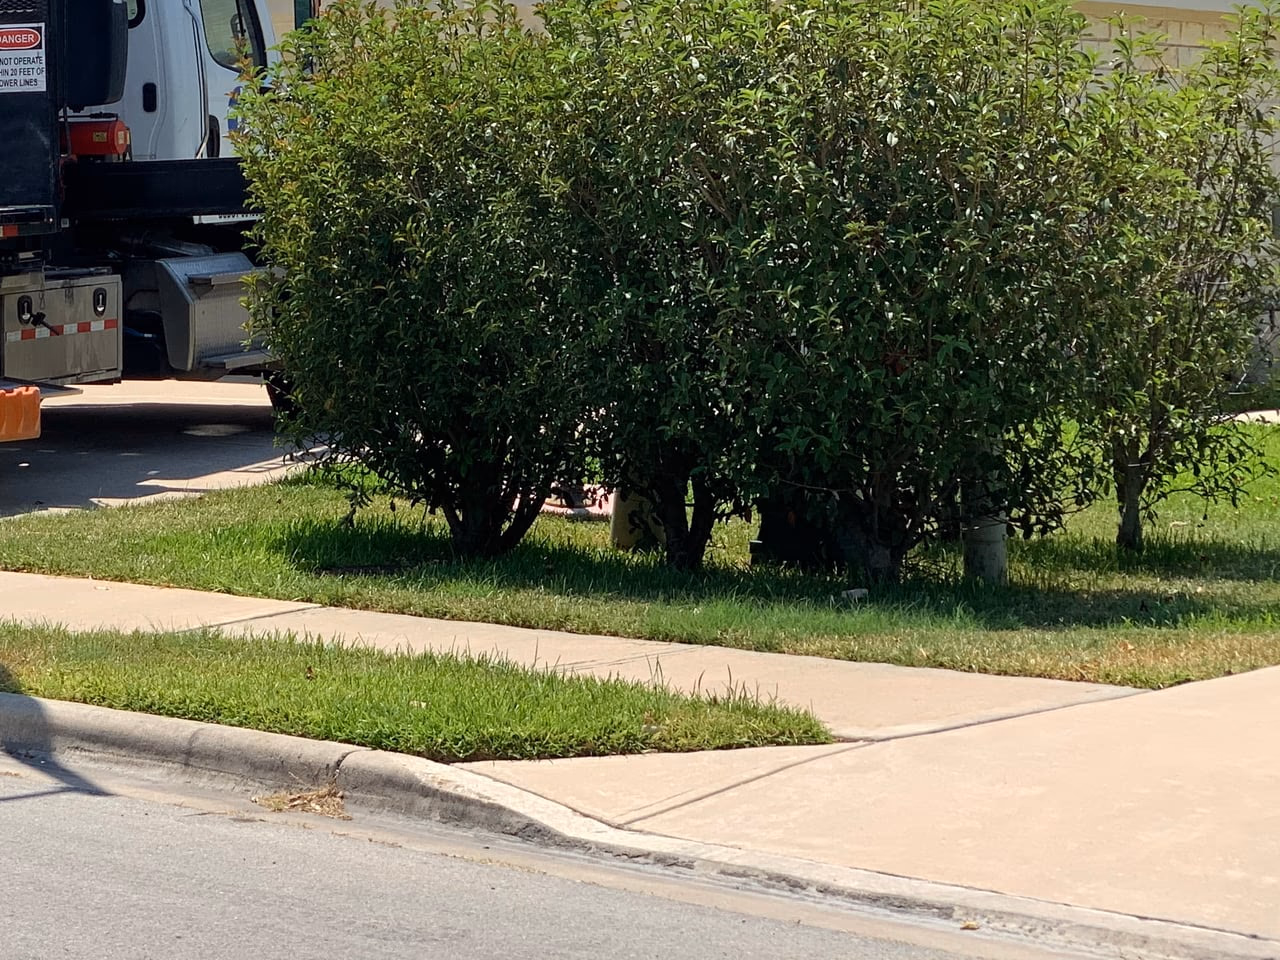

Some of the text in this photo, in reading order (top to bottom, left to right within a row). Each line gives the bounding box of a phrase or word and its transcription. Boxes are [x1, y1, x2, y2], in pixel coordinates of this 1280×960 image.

[0, 57, 12, 66] NOT
[13, 56, 43, 66] OPERATE
[18, 67, 35, 76] FEET
[36, 67, 45, 76] OF
[19, 78, 38, 87] LINES
